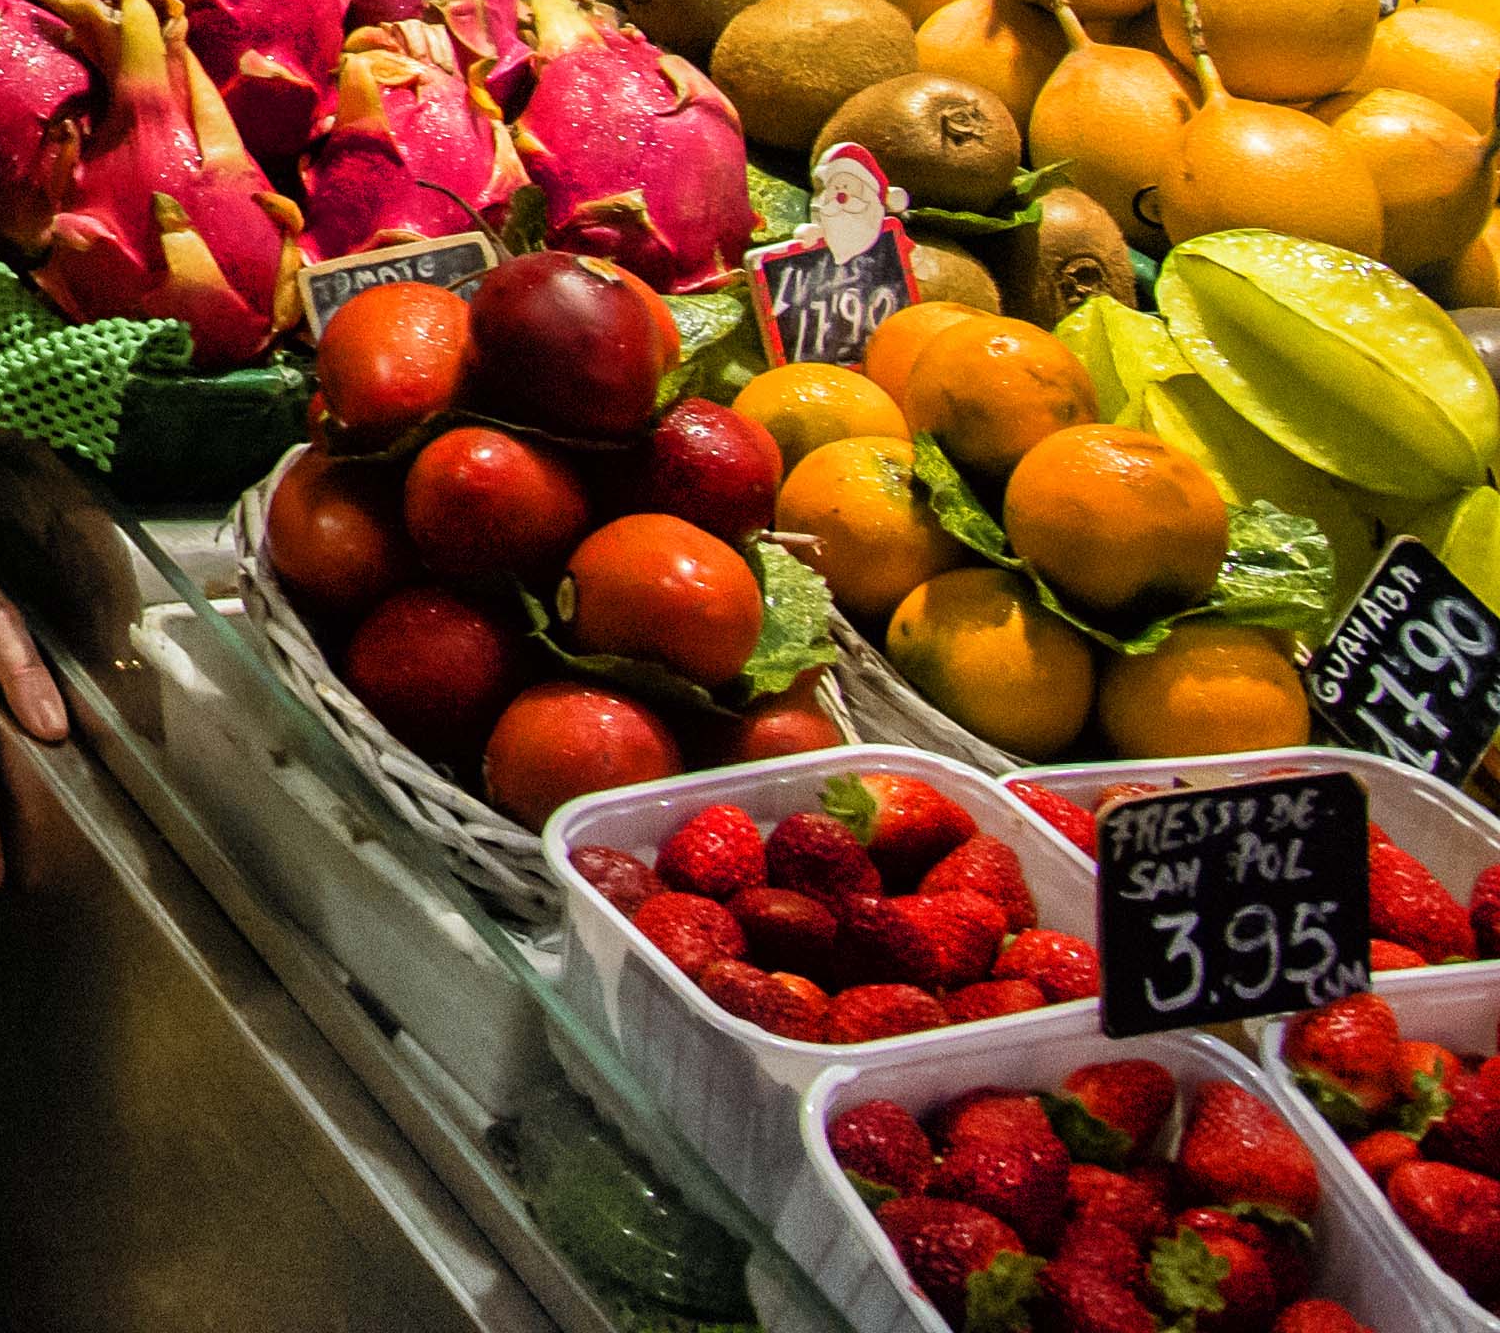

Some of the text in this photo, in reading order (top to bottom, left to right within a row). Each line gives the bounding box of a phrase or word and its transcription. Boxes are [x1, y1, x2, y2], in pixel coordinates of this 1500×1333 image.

[1310, 561, 1424, 704] GUAYABA
[1226, 832, 1314, 882] POL
[1144, 901, 1340, 1014] 3.95
